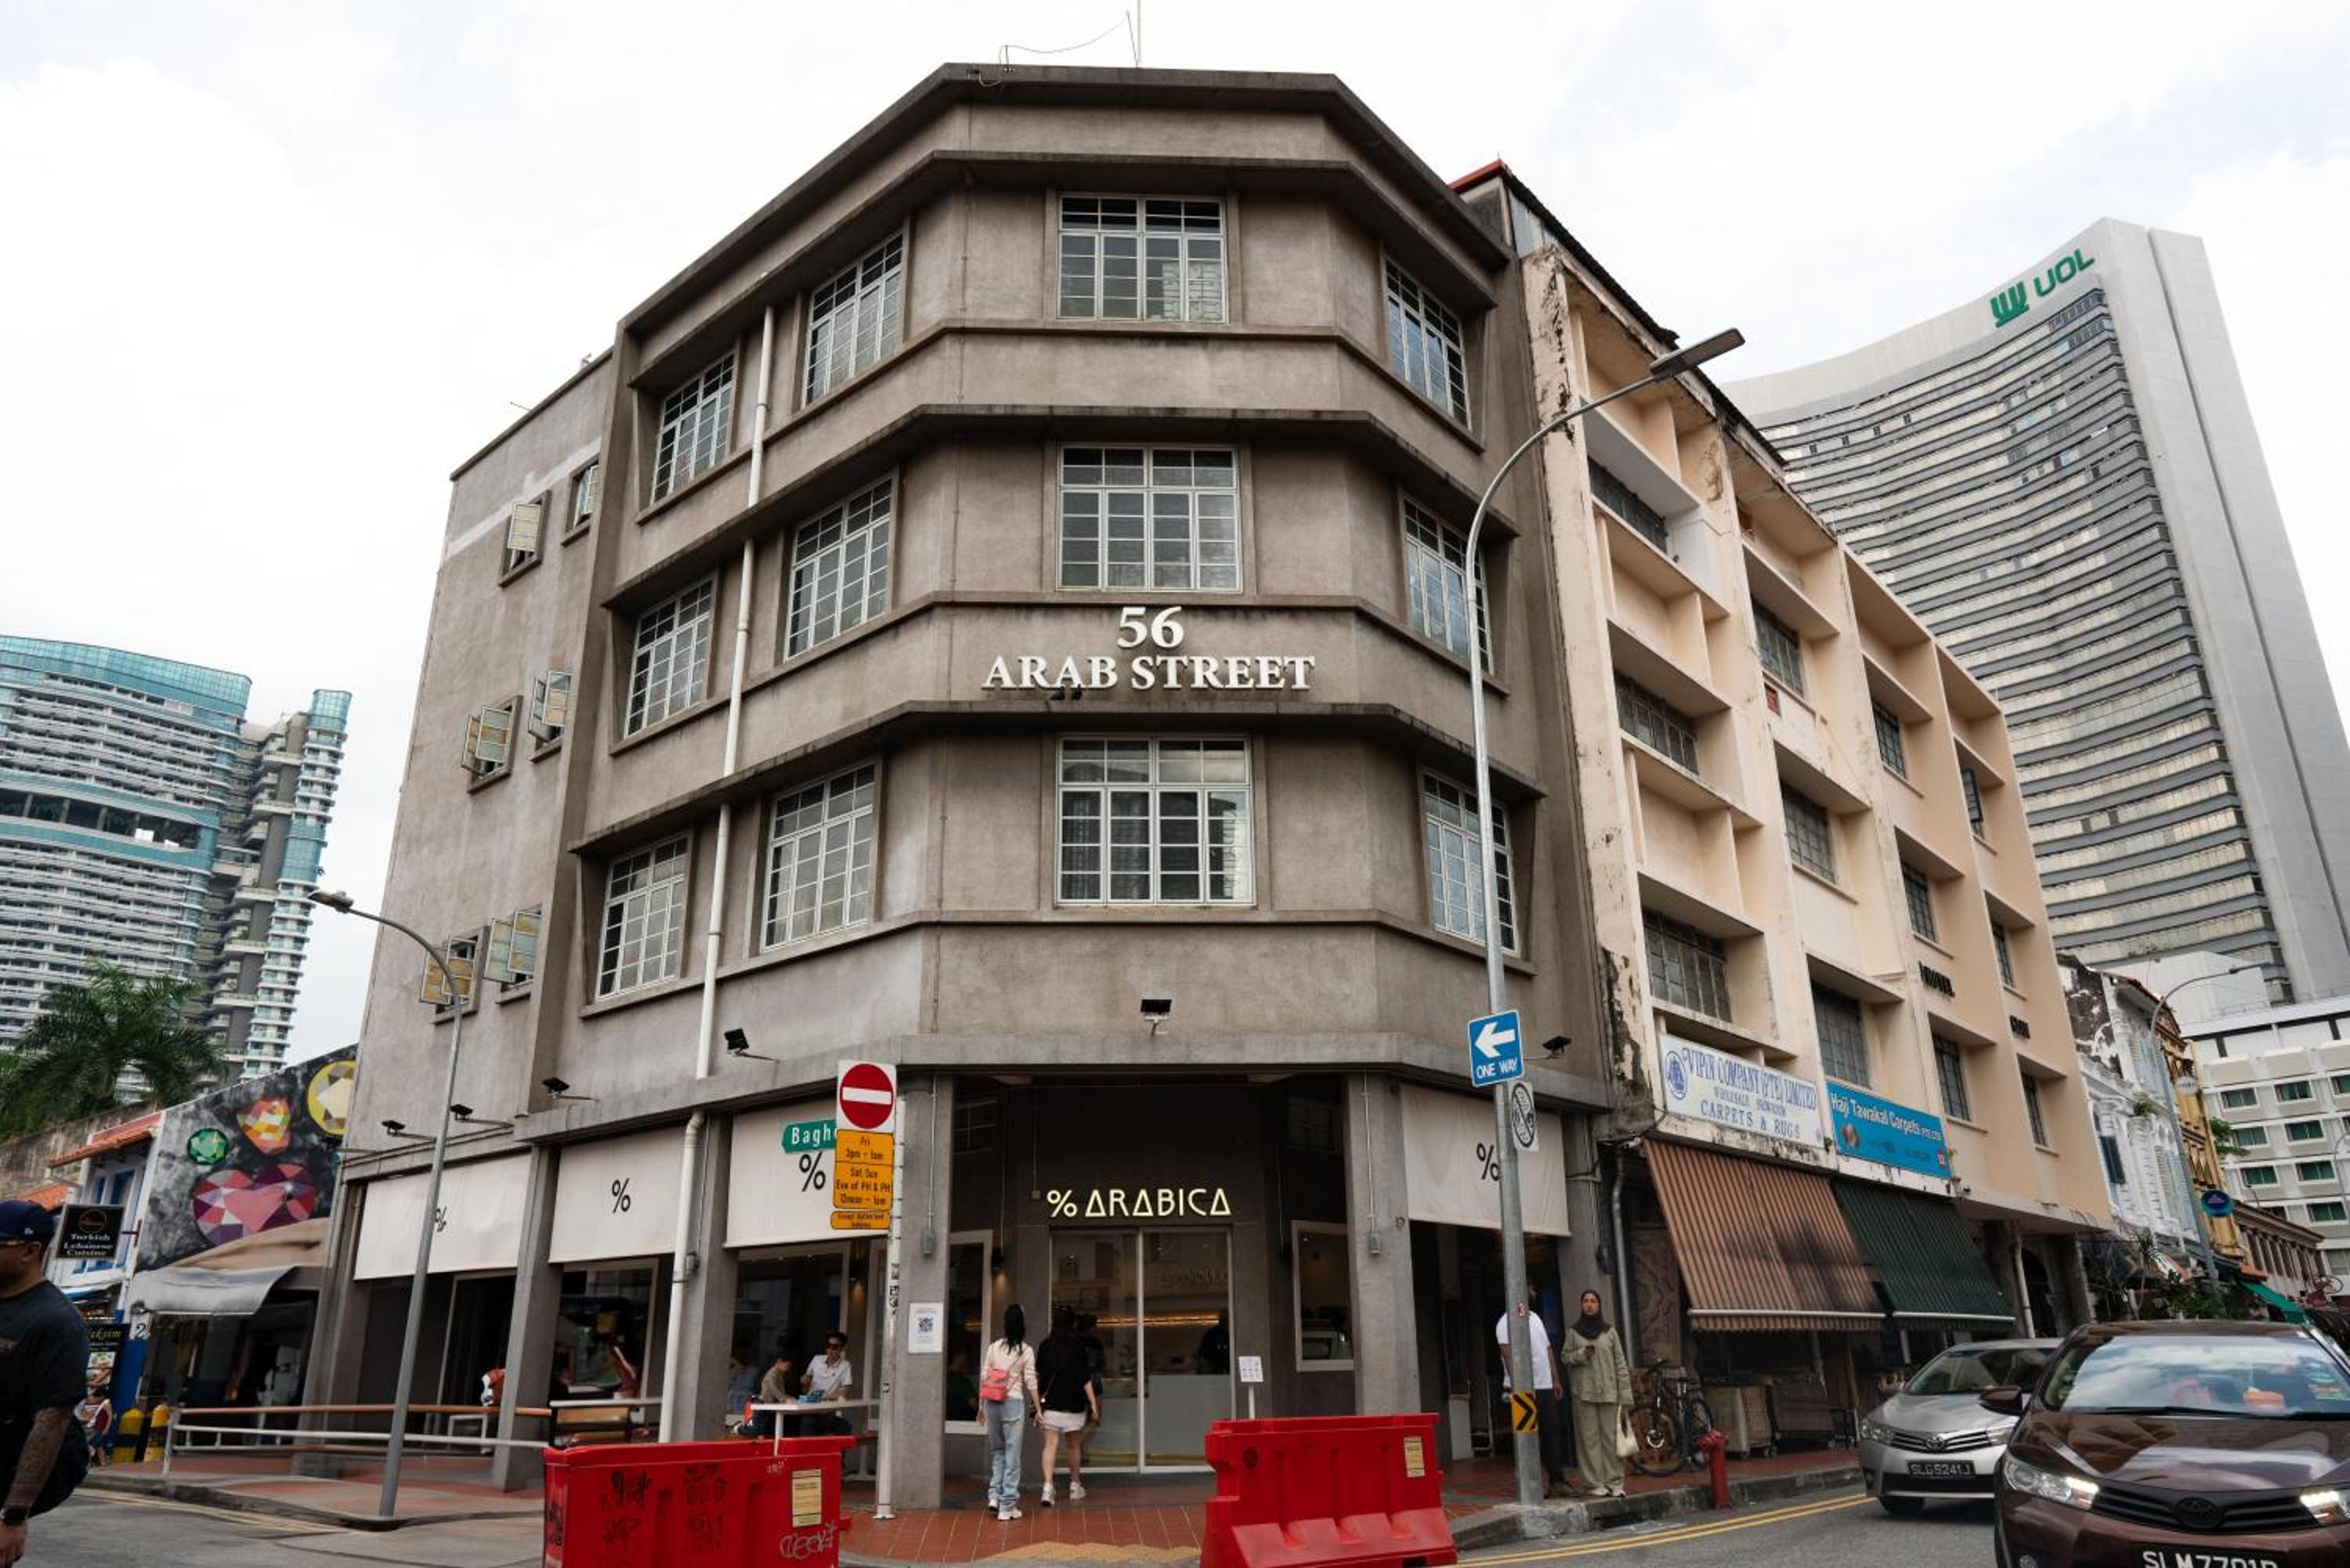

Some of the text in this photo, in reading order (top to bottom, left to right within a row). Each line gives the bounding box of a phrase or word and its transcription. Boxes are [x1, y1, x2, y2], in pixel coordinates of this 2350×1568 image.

[2034, 248, 2095, 297] UOL
[1117, 605, 1184, 649] 56
[981, 656, 1314, 690] ARAB STREET
[1477, 1058, 1517, 1078] ONE WAY
[1718, 1057, 1760, 1093] COMPANY
[1785, 1078, 1817, 1111] LIMITED
[1701, 1100, 1754, 1128] CARPETS
[1774, 1118, 1799, 1139] RUGS
[1830, 1093, 1849, 1118] Haji
[1850, 1099, 1889, 1125] Tawakal
[1889, 1111, 1920, 1136] Carpets
[859, 1137, 870, 1146] Fri
[612, 1177, 631, 1214] %
[836, 1180, 848, 1189] Eve
[1047, 1188, 1231, 1217] % ARABICA
[71, 1233, 110, 1241] Turkish
